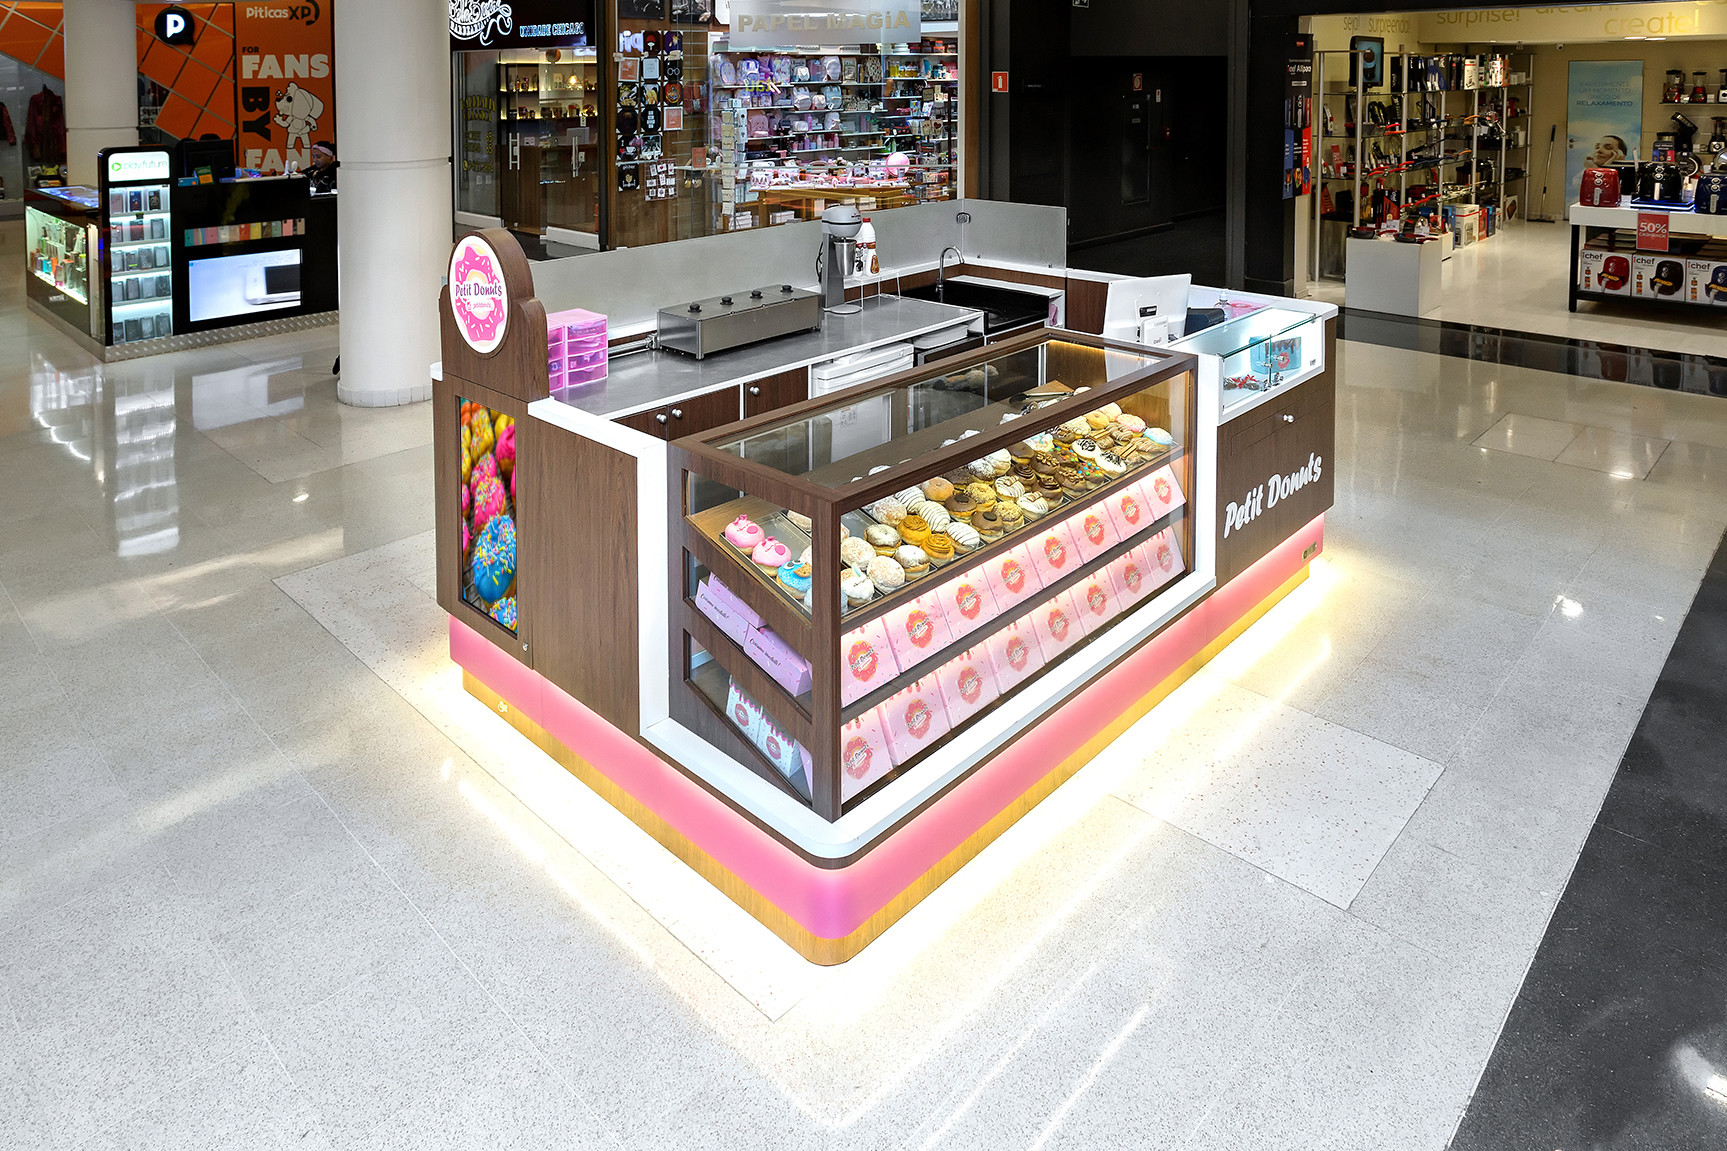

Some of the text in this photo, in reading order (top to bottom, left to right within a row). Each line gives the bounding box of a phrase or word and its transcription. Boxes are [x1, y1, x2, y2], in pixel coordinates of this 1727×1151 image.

[738, 15, 817, 32] PAPEL
[1436, 9, 1520, 28] surprise!
[1604, 9, 1700, 35] create!
[519, 22, 584, 37] UNIDADE CHICAGO
[242, 46, 260, 54] FOR
[242, 54, 330, 79] FANS
[242, 86, 271, 142] BY
[1638, 222, 1668, 234] 50%
[455, 281, 502, 297] Petit Donuts
[1224, 452, 1322, 539] Petit Donuts
